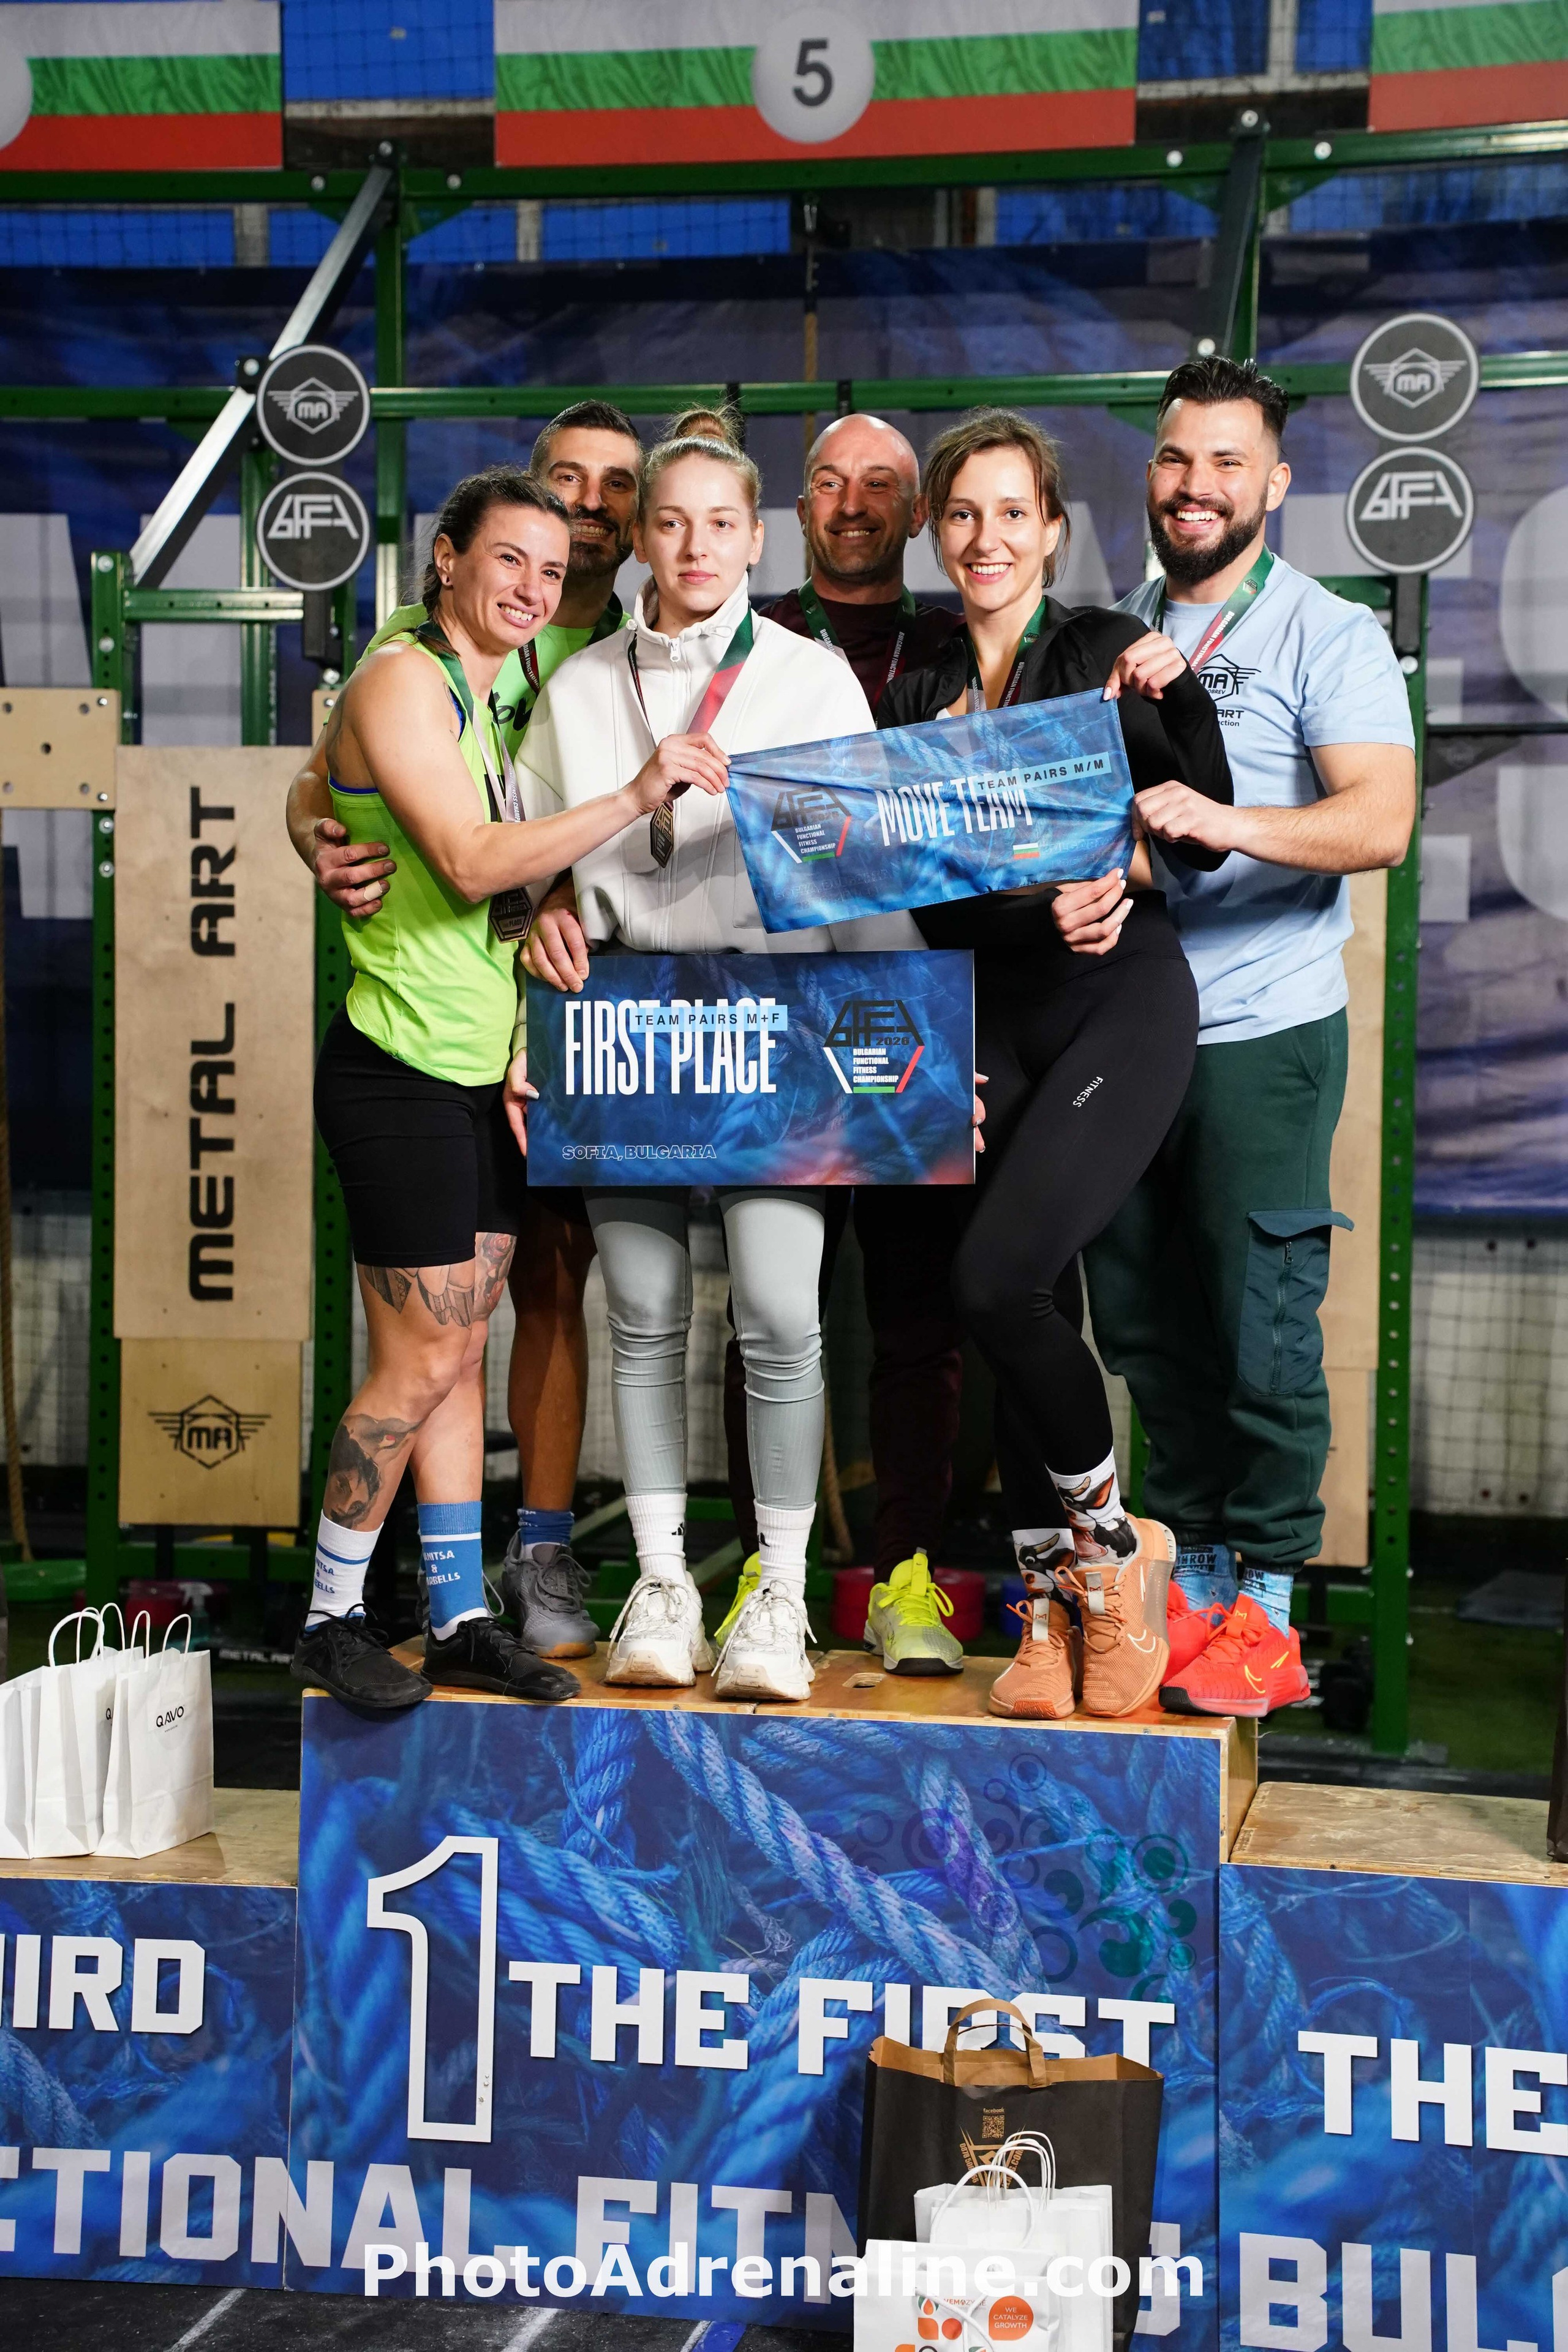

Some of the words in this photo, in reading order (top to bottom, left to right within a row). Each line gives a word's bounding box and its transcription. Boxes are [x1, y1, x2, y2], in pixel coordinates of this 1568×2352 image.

[793, 38, 833, 107] 5
[1210, 611, 1235, 642] BULGARIAN
[978, 776, 1017, 791] TEAM
[1023, 766, 1068, 784] PAIRS
[1074, 758, 1104, 774] M/M
[875, 781, 956, 847] MOVE
[951, 768, 1033, 834] TEAM
[795, 824, 822, 834] BULGARIAN
[797, 831, 825, 841] FUNCTIONAL
[799, 839, 818, 848] FITNESS
[801, 842, 837, 854] CHAMPIONSHIP
[190, 786, 236, 957] ART
[635, 1013, 680, 1027] TEAM
[688, 1012, 738, 1025] PAIRS
[747, 1011, 780, 1025] M+F
[565, 999, 662, 1096] FIRST
[671, 998, 777, 1095] PLACE
[1072, 1076, 1104, 1108] FITNESS
[189, 1002, 237, 1302] METAL
[562, 1145, 623, 1161] SOFIA,
[625, 1145, 717, 1159] BULGARIA
[187, 1426, 232, 1450] MA
[156, 1706, 185, 1728] QAVO
[0, 1933, 206, 2034] IRD
[367, 1835, 499, 2143] 1
[508, 1961, 750, 2071] THE
[1297, 2030, 1568, 2156] THE
[1239, 2233, 1568, 2352] BUL
